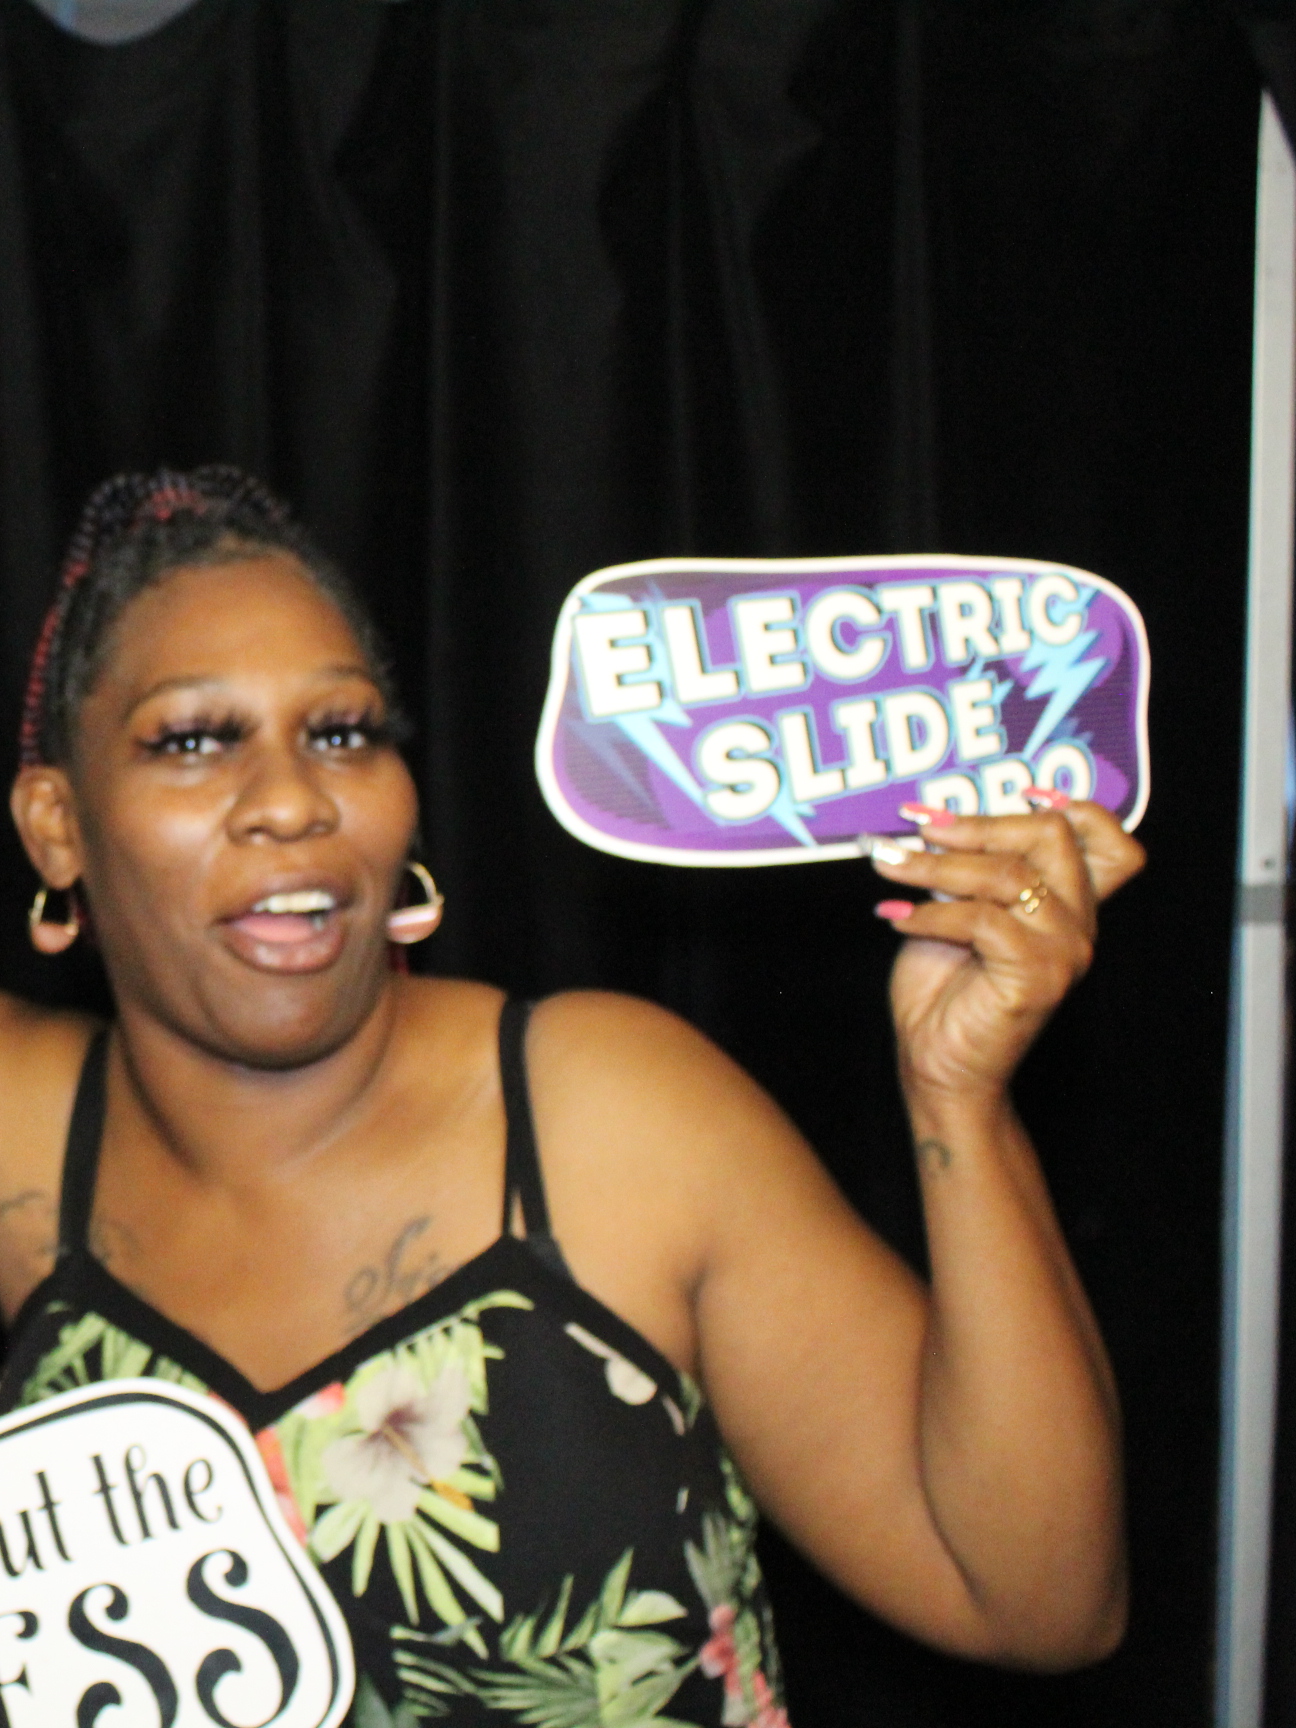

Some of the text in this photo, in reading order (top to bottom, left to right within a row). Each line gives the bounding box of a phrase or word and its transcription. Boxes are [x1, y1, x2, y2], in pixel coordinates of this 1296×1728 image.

[572, 574, 1084, 718] ELECTRIC
[699, 678, 1002, 820] SLIDE
[92, 1443, 225, 1547] the
